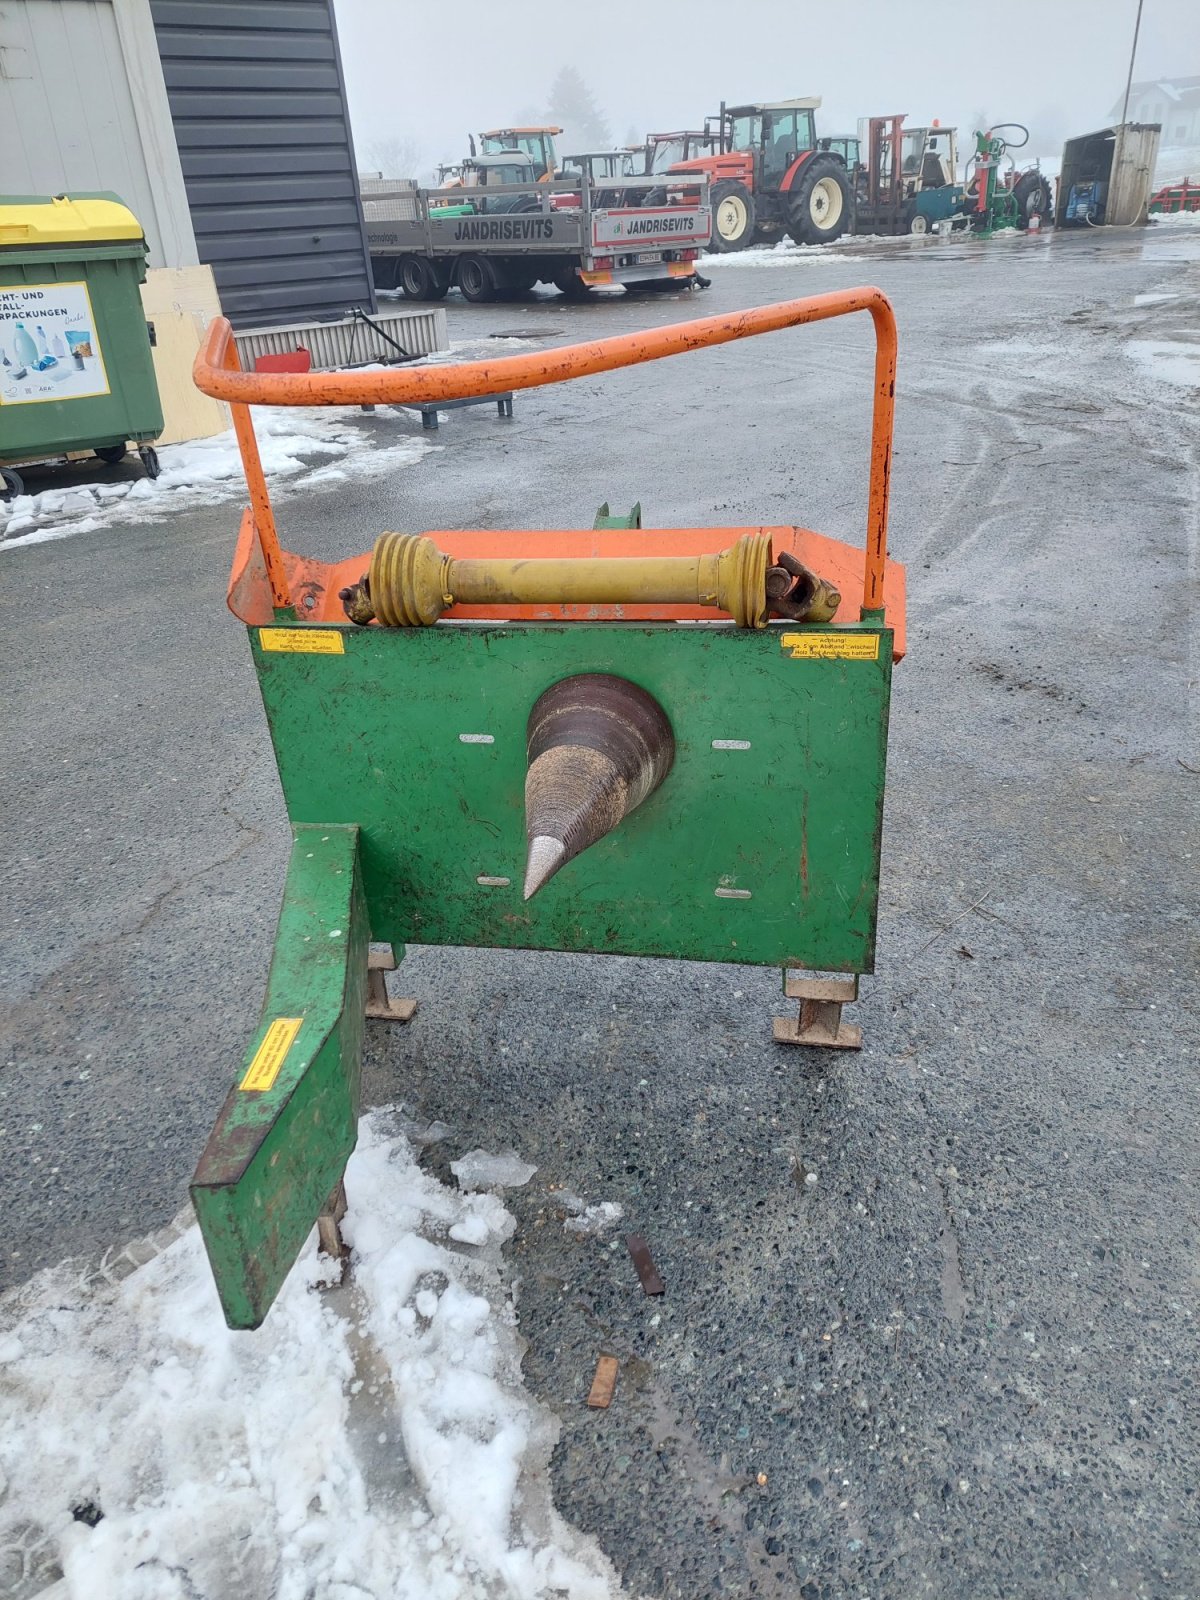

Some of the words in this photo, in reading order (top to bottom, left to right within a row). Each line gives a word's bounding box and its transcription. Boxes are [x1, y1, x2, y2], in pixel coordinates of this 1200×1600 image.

[454, 218, 553, 240] JANDRISEVITS
[627, 217, 694, 235] JANDRISEVITS
[22, 291, 44, 300] UND
